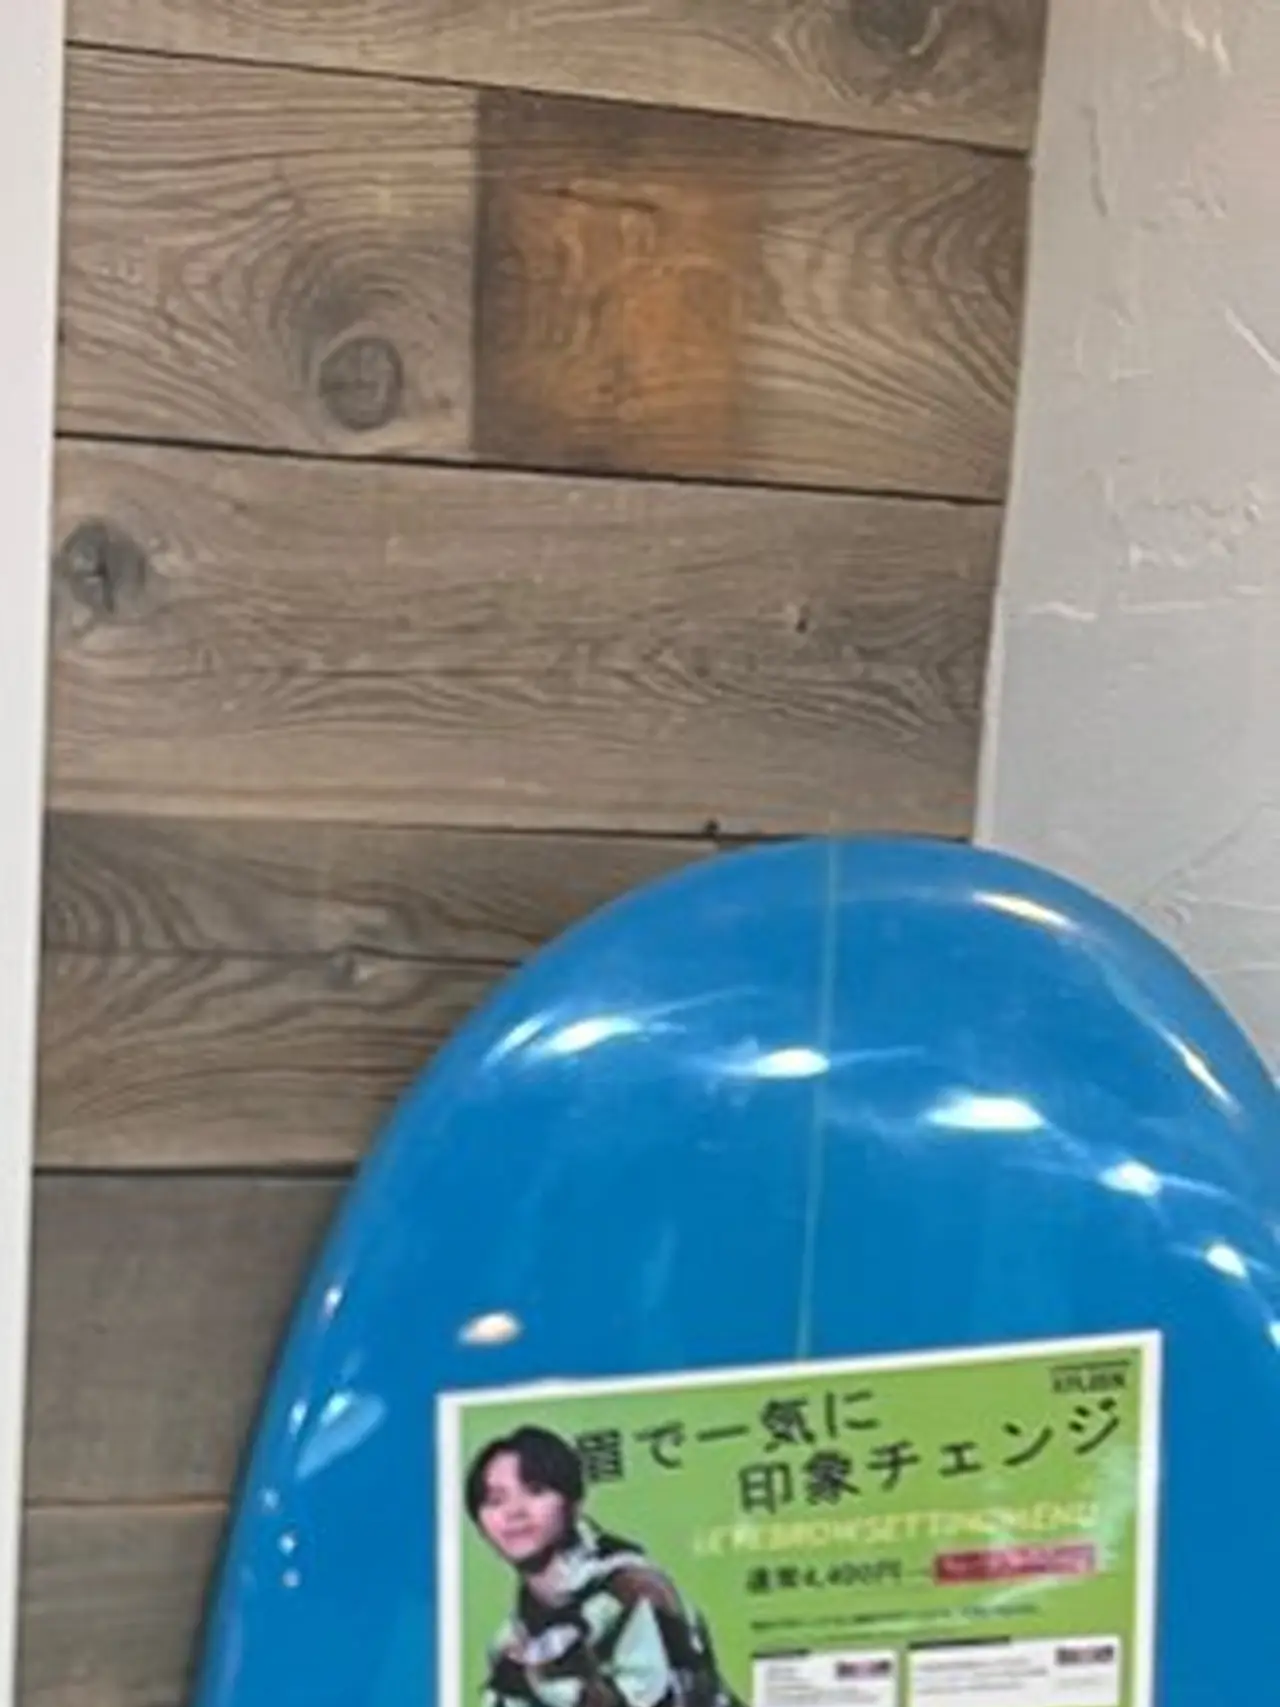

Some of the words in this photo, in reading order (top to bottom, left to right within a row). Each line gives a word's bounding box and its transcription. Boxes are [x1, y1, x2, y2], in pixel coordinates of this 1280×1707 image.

[738, 1397, 1123, 1515] 印象チェンジ
